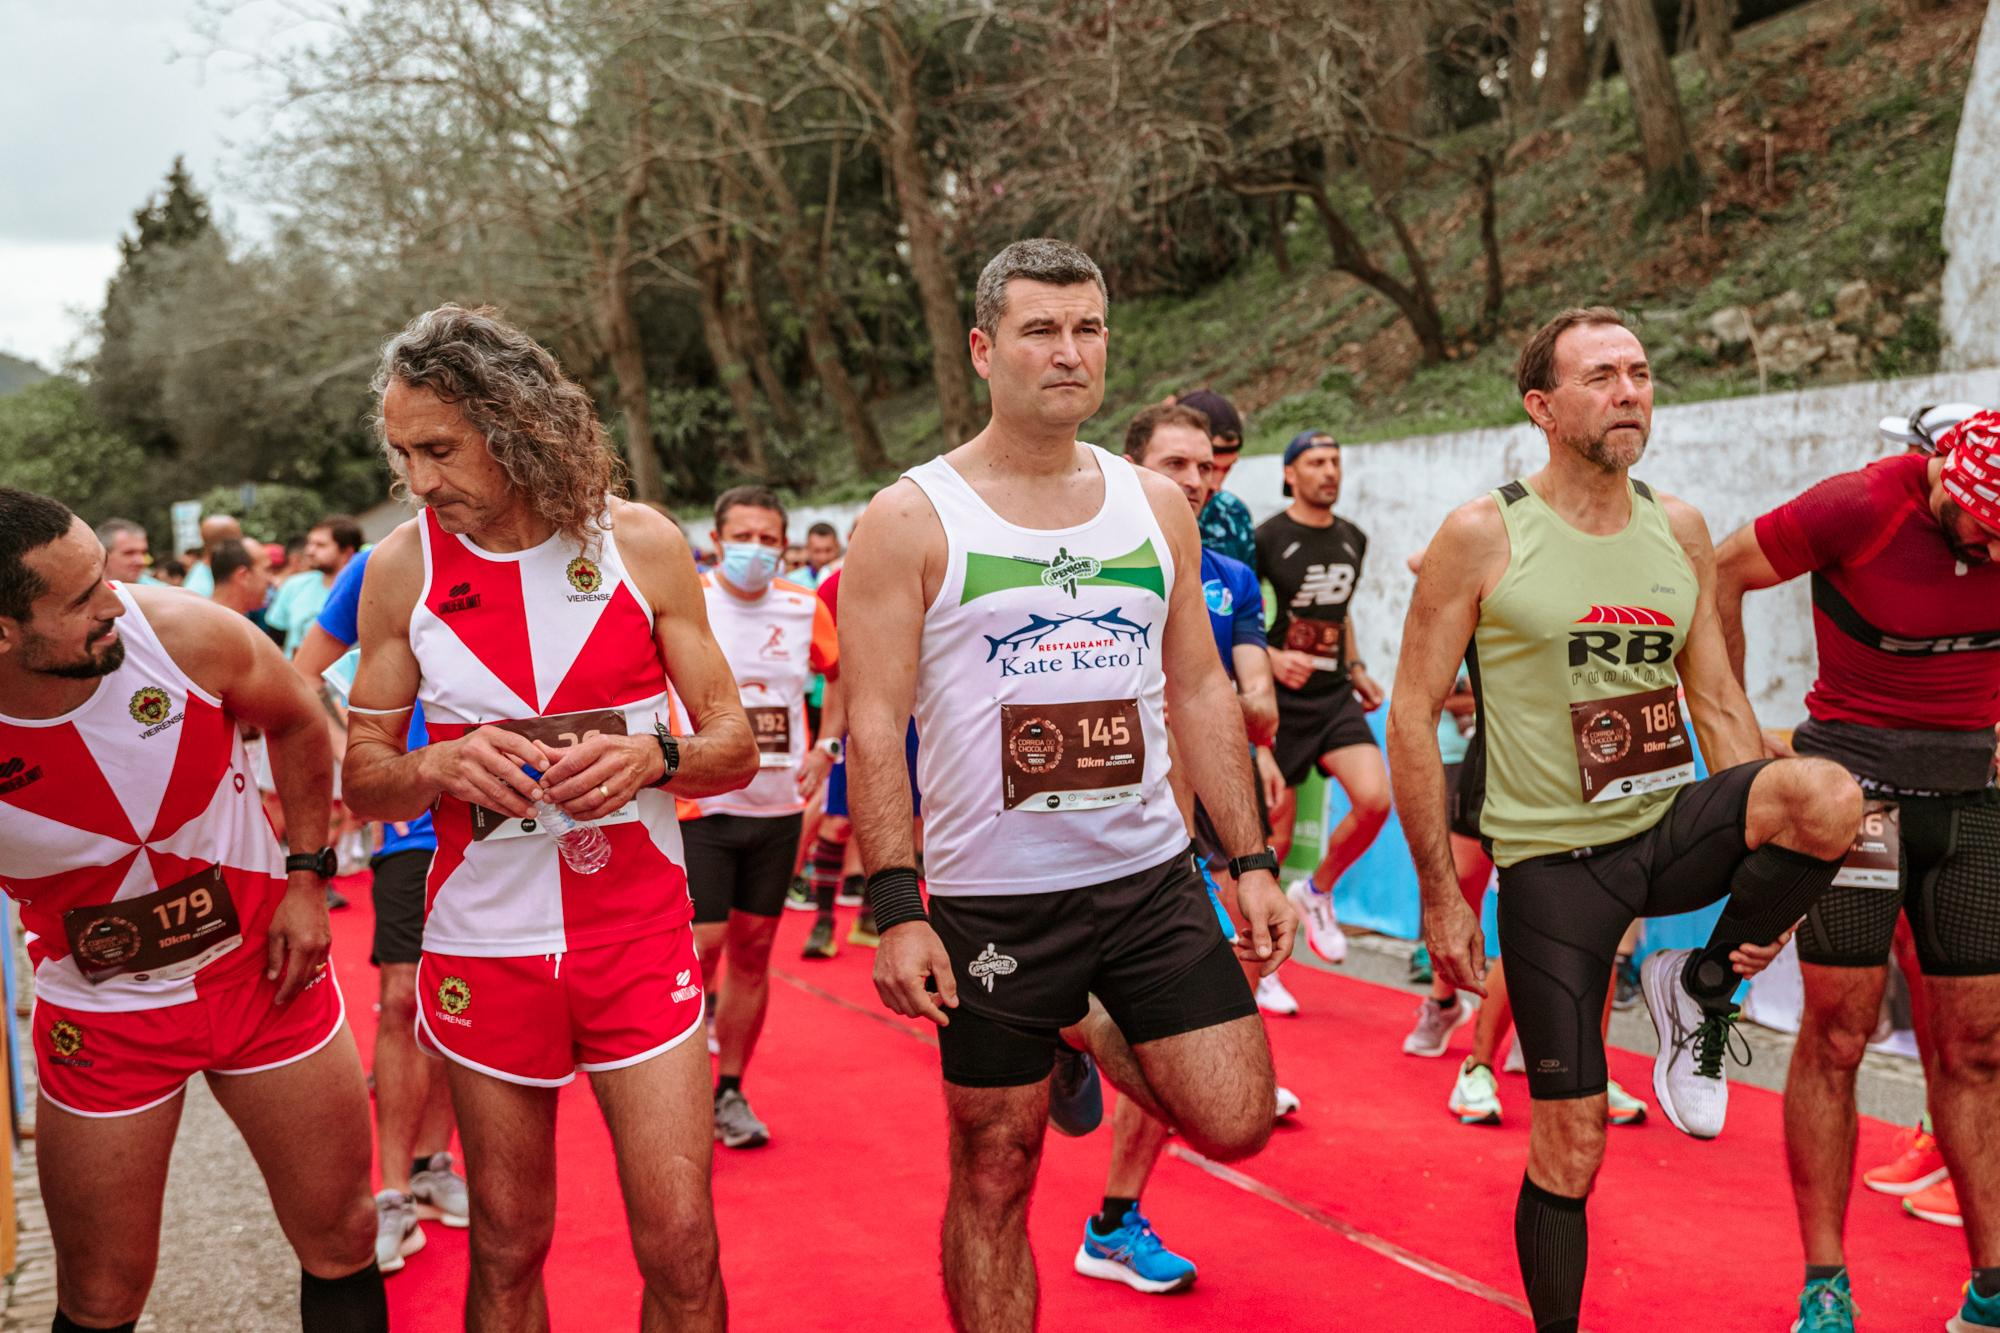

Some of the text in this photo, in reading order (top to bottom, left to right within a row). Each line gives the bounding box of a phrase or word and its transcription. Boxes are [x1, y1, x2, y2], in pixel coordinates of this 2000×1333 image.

[1051, 560, 1091, 580] PENICHE
[566, 593, 611, 603] VIEIRENSE
[1038, 639, 1115, 652] RESTAURANTE
[1568, 630, 1674, 667] RB
[1000, 655, 1062, 678] Kate
[1071, 649, 1130, 670] Kero
[138, 712, 185, 740] VIEIRENSE
[755, 713, 786, 733] 192
[1640, 700, 1676, 734] 186
[1077, 716, 1130, 748] 145
[1643, 741, 1666, 753] 10km
[1076, 757, 1105, 769] 10km
[153, 887, 214, 930] 179
[158, 932, 192, 949] 10km
